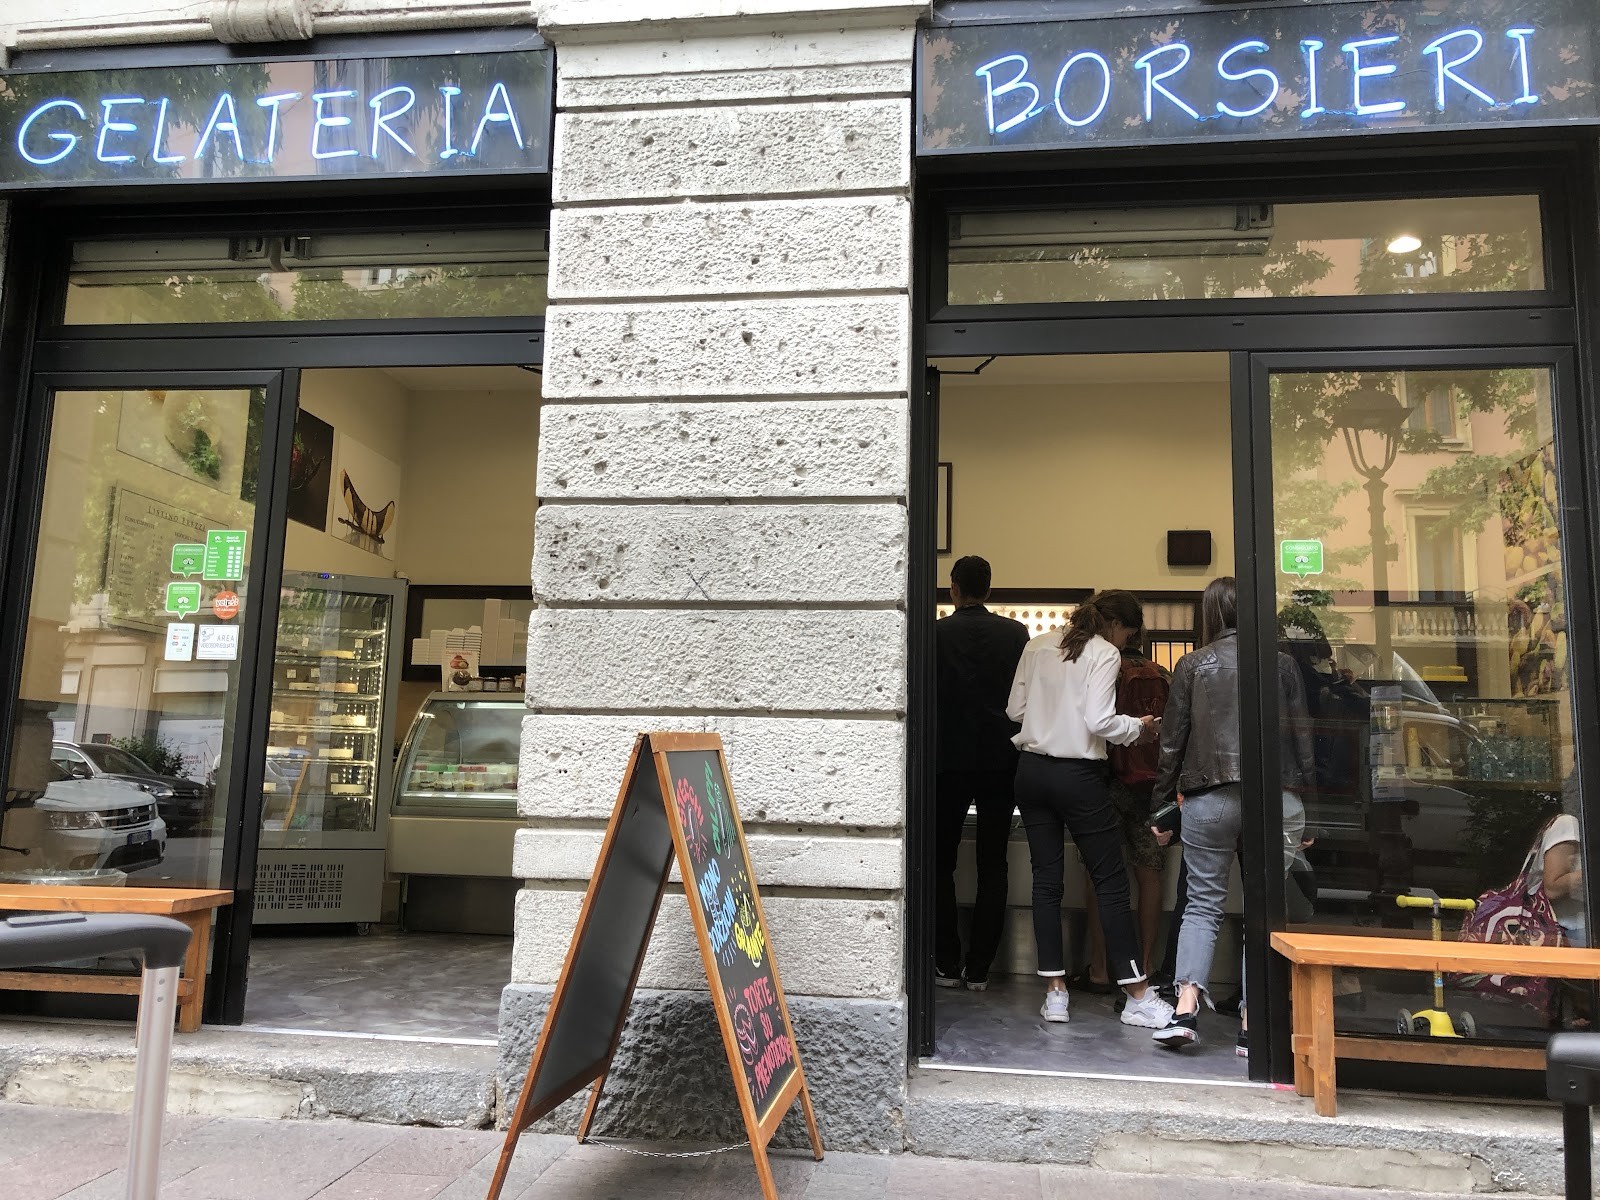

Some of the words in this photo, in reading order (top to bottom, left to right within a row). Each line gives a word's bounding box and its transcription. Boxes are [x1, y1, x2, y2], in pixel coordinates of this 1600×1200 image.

[975, 27, 1539, 134] BORSIERI
[16, 82, 525, 165] GELATERIA
[216, 634, 235, 642] AREA
[699, 857, 721, 912] MONO
[708, 885, 737, 955] PORZIONI
[734, 920, 766, 961] GRANITE
[743, 975, 773, 1018] TORTE
